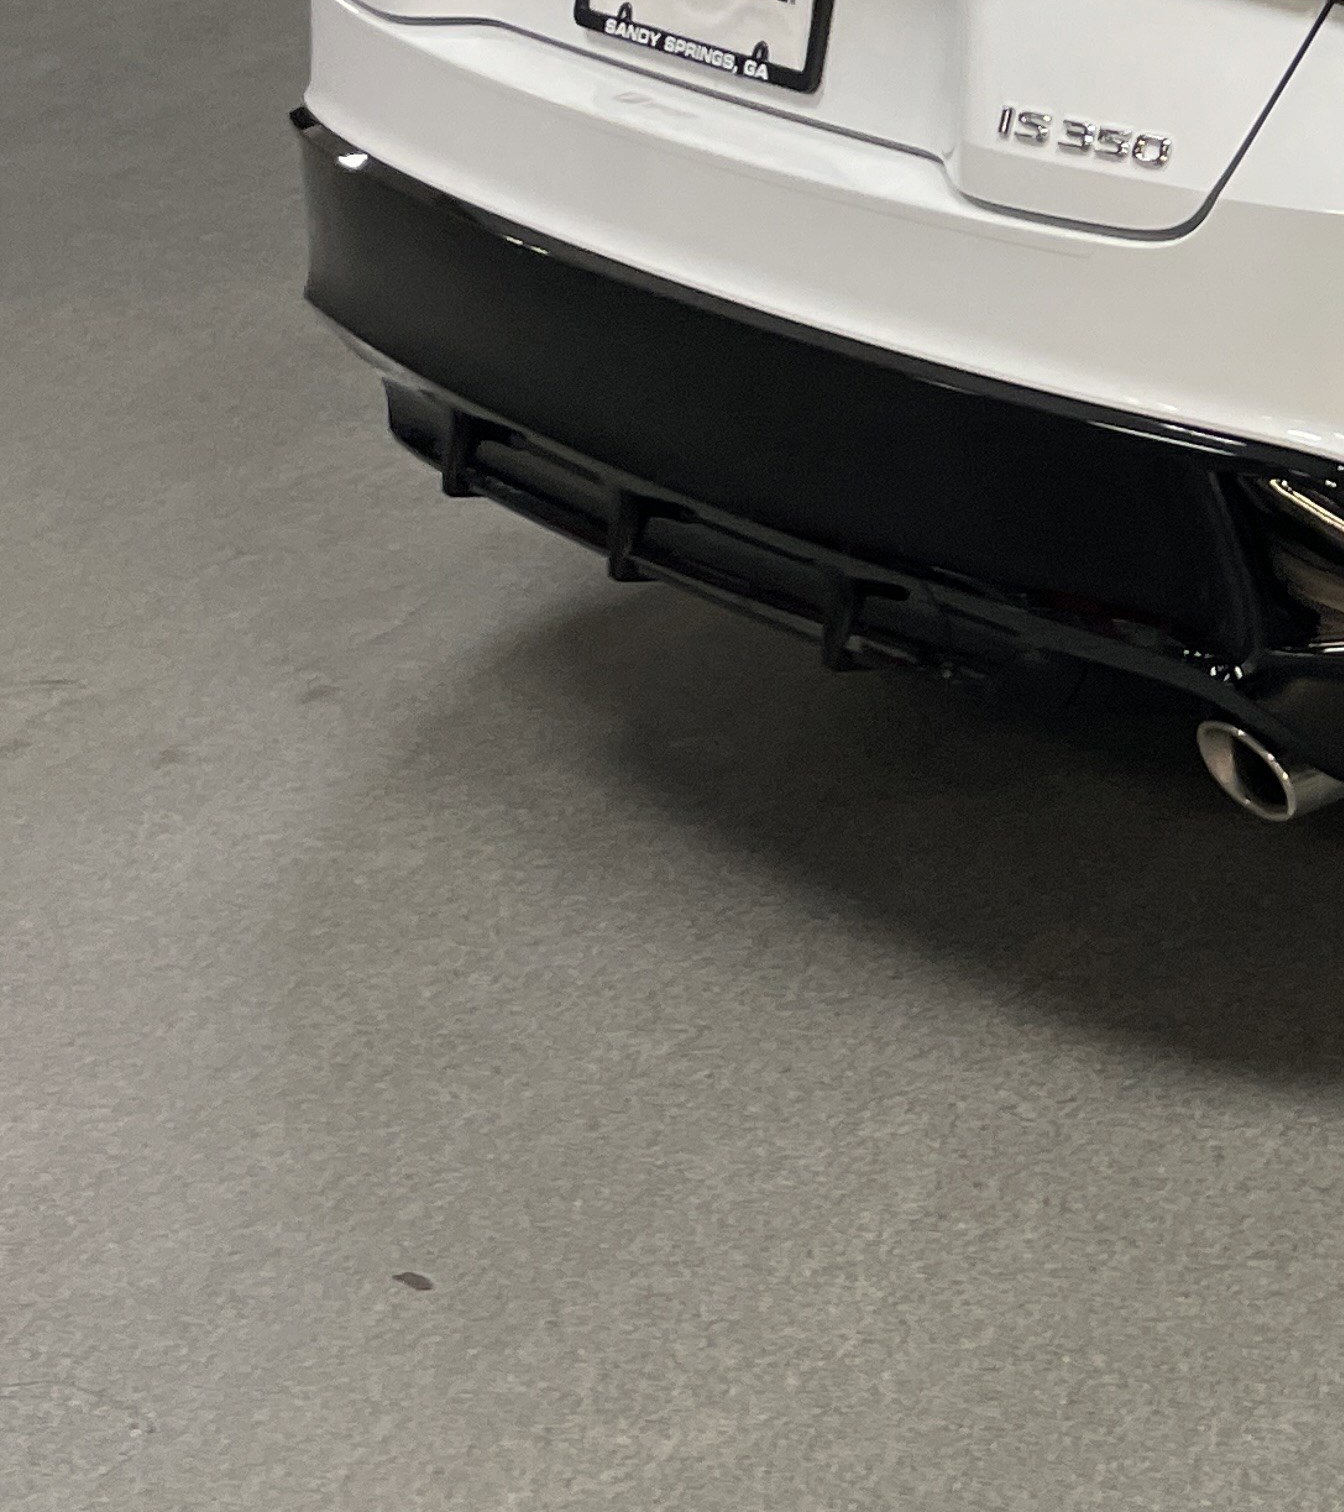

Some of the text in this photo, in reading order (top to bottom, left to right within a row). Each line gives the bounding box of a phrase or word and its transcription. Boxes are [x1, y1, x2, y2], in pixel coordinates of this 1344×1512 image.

[604, 18, 769, 81] SANDY SPRINGS, GA
[998, 105, 1173, 168] IS 350
